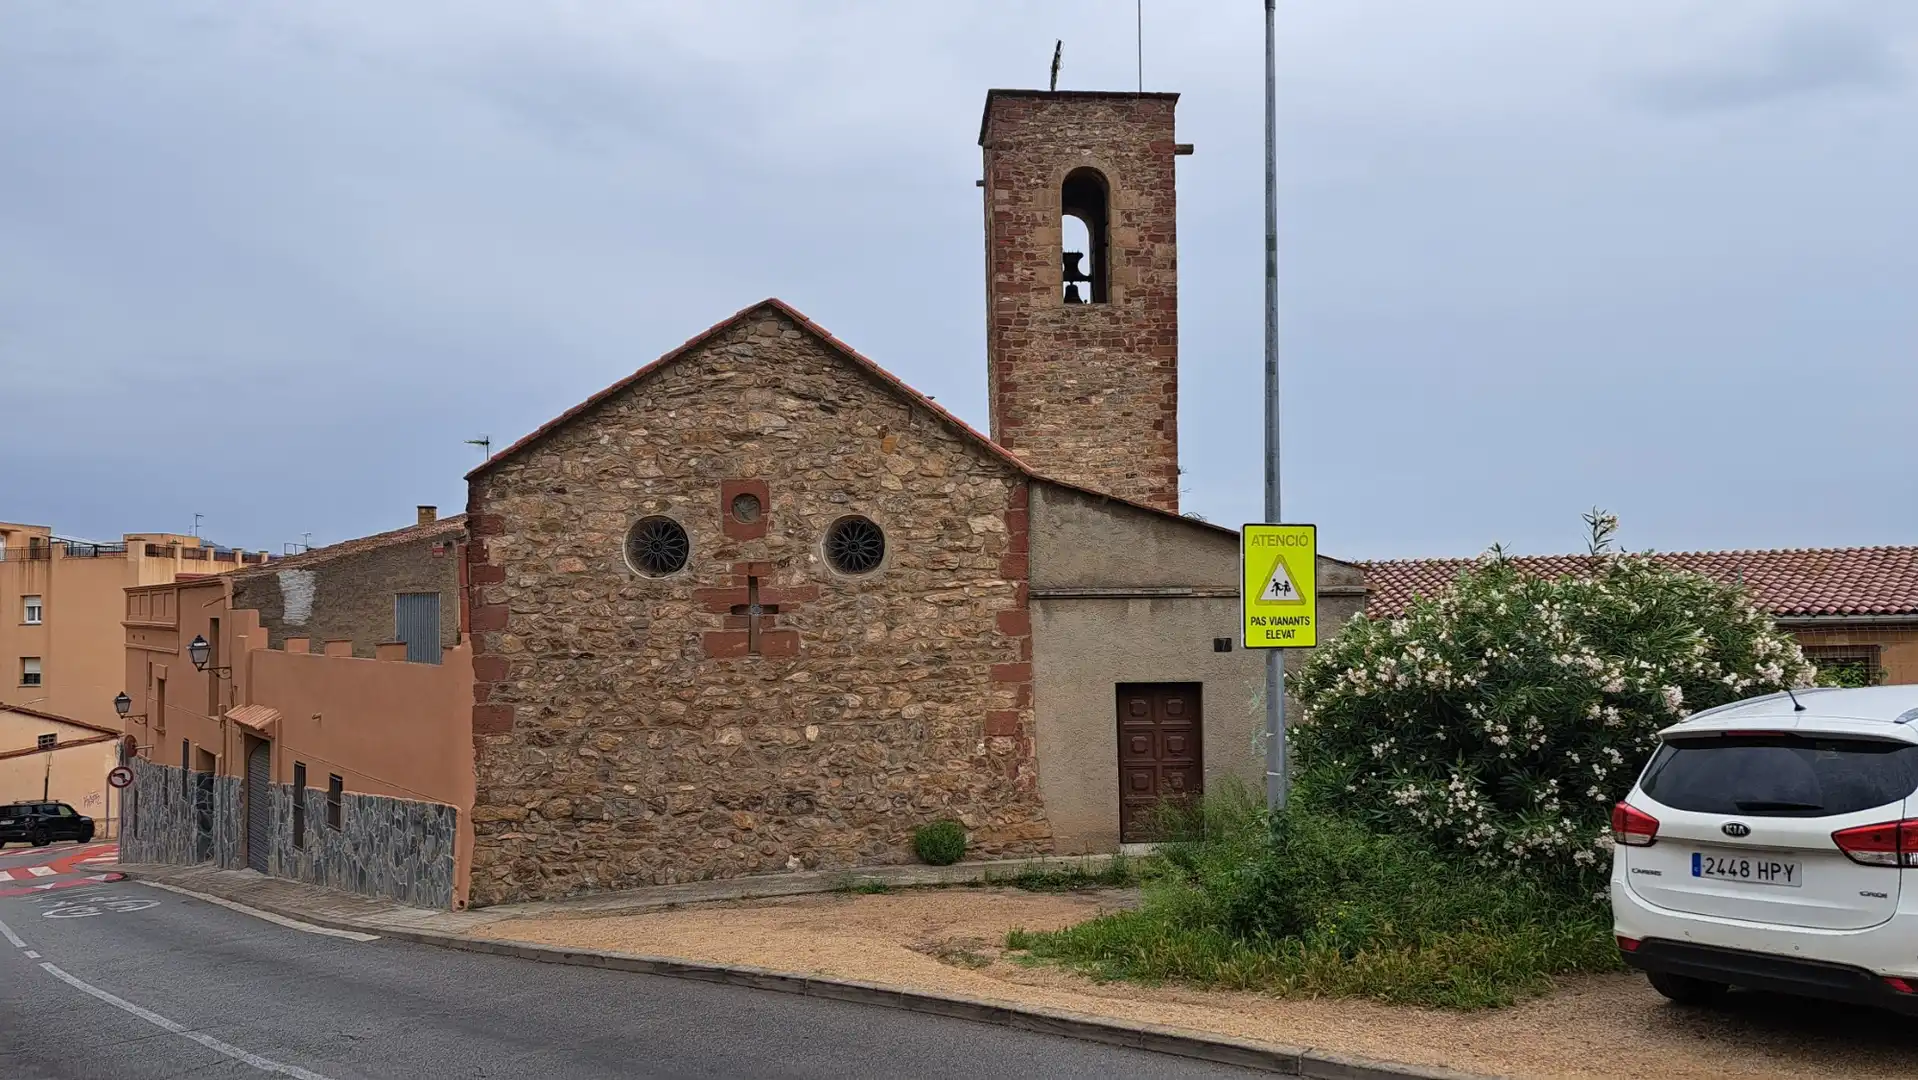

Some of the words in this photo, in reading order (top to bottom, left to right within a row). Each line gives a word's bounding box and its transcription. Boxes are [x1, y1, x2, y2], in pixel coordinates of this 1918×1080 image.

[1251, 532, 1308, 547] ATENCIÓ
[1250, 616, 1266, 626] PAS
[1269, 616, 1310, 626] VIANANTS
[1265, 629, 1295, 639] ELEVAT
[1725, 824, 1746, 835] KIA
[1705, 857, 1750, 878] 2448
[1758, 862, 1795, 882] HPY
